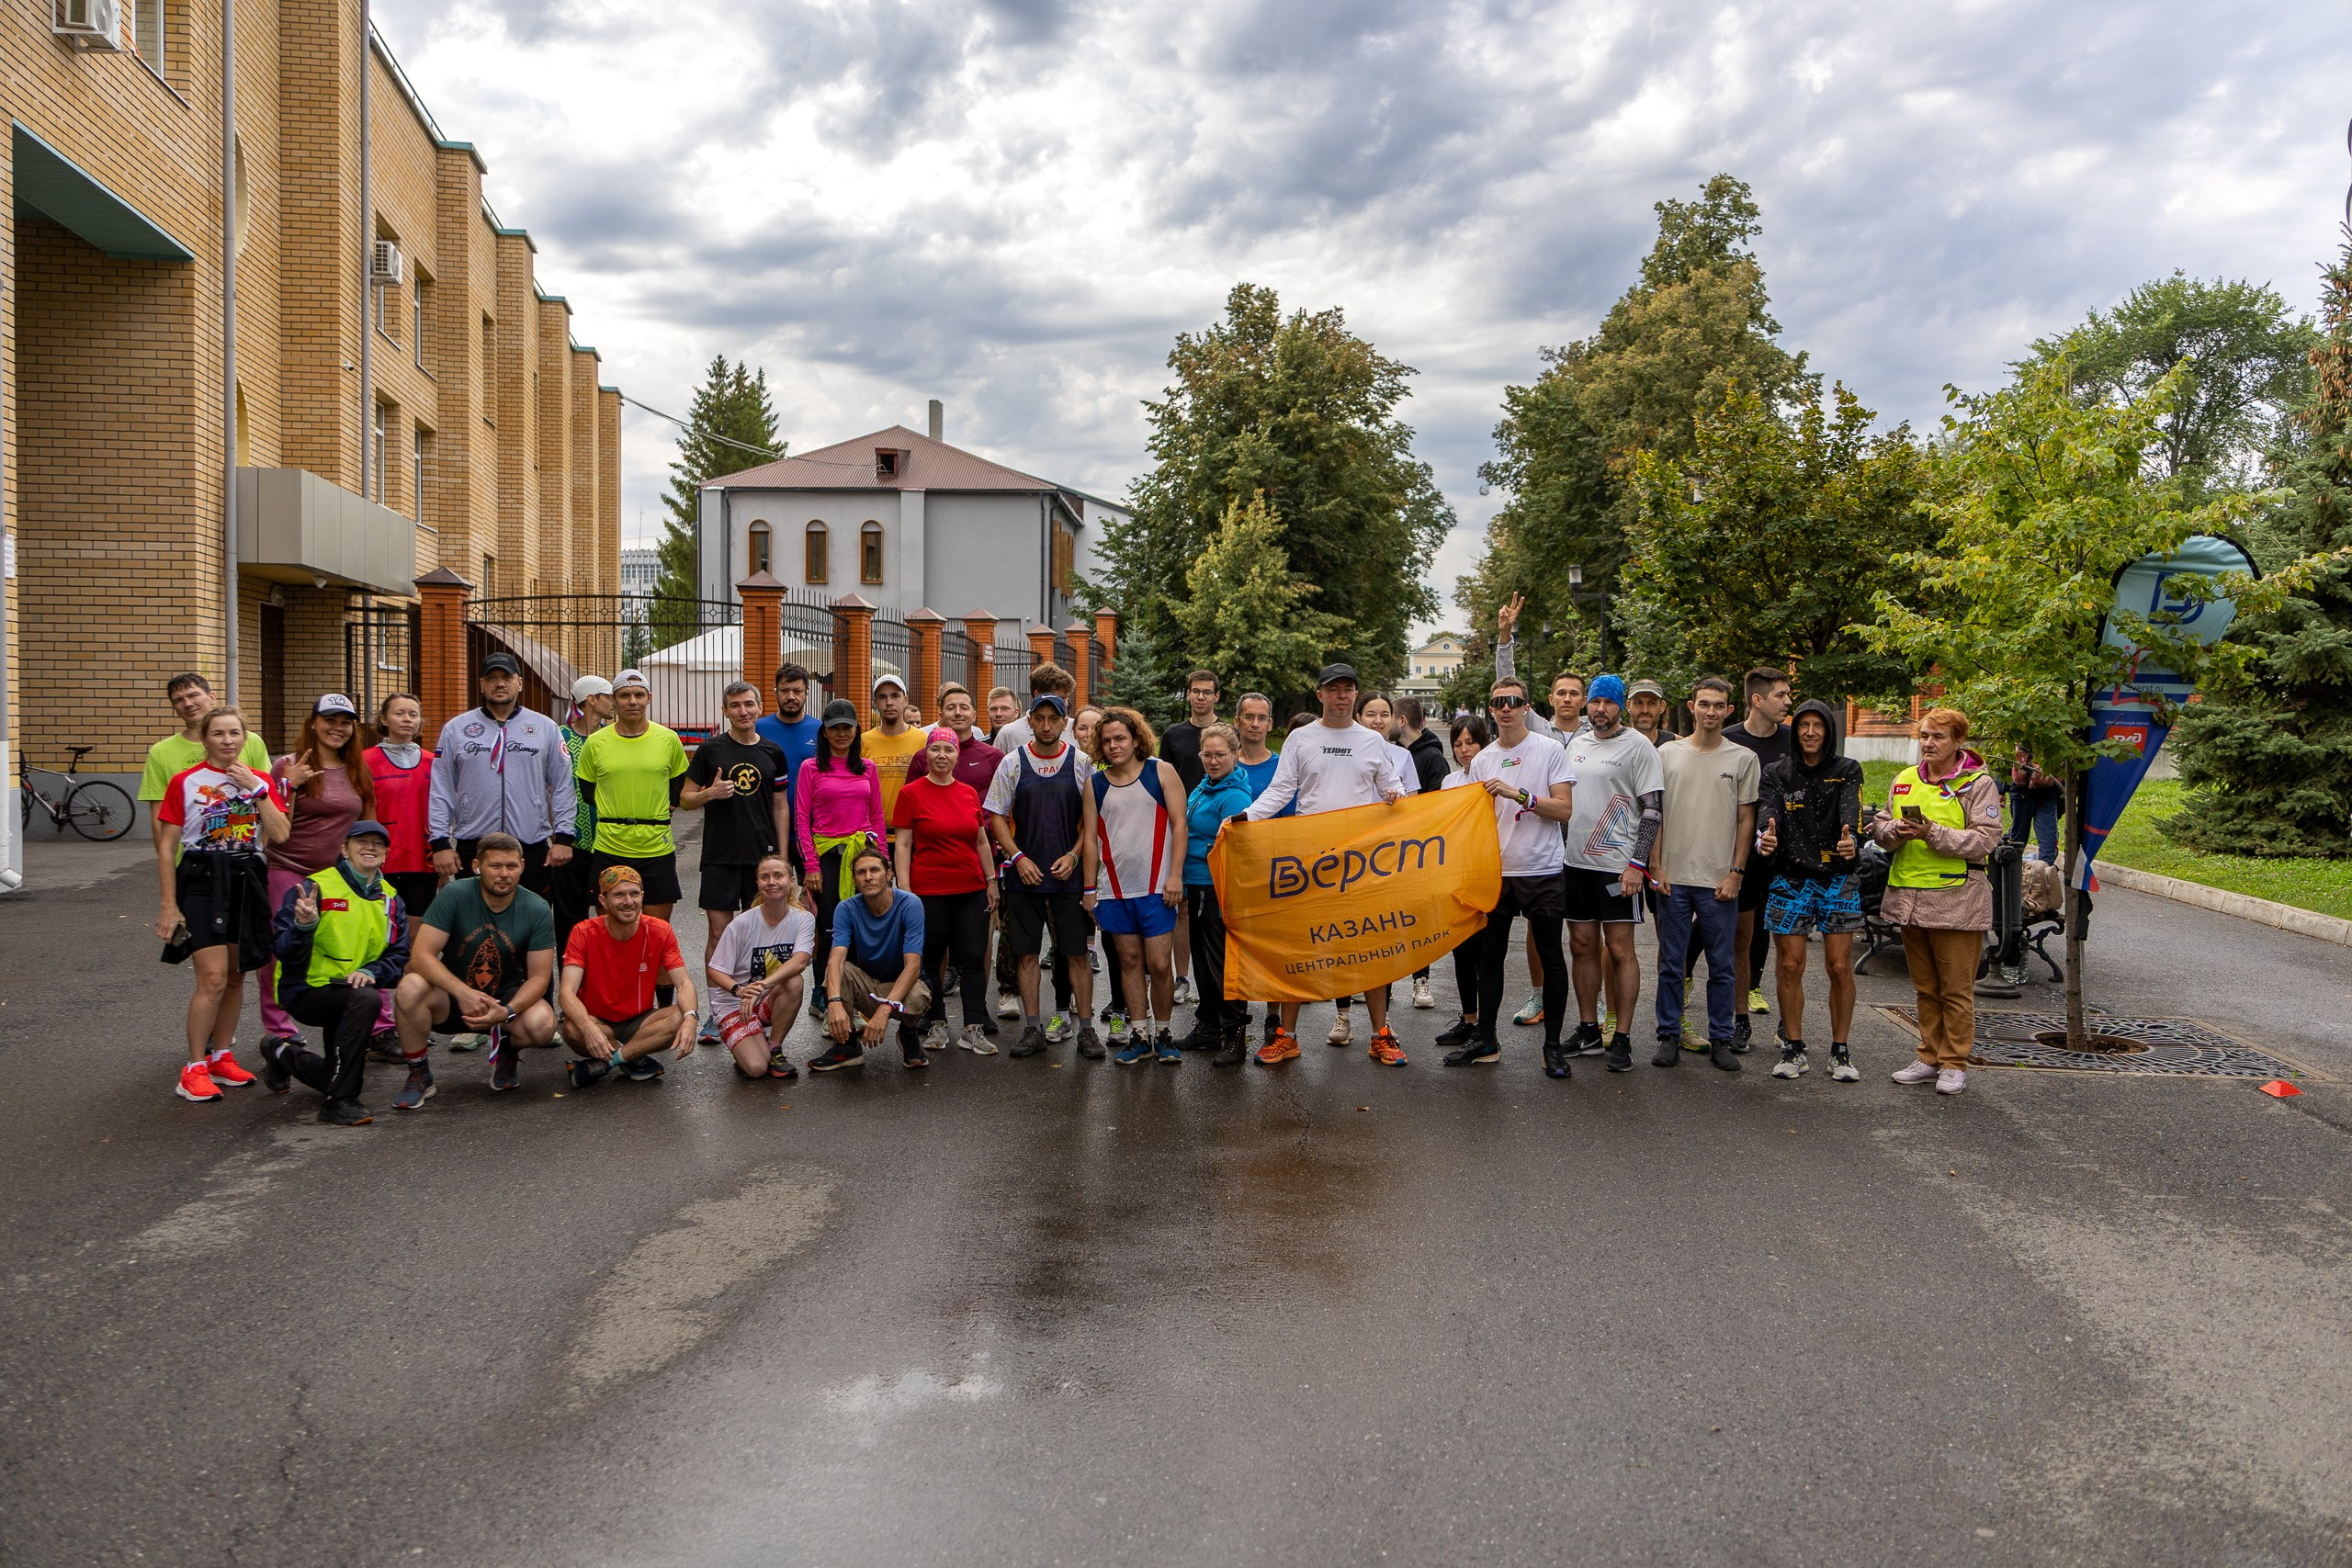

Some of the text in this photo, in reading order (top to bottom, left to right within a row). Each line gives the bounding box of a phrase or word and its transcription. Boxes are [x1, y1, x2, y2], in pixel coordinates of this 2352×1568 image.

[1833, 900, 1853, 911] TREC
[1309, 909, 1417, 945] КАЗАНЬ
[1285, 928, 1451, 976] ЦЕНТРАЛЬНЫЙ ПАРК
